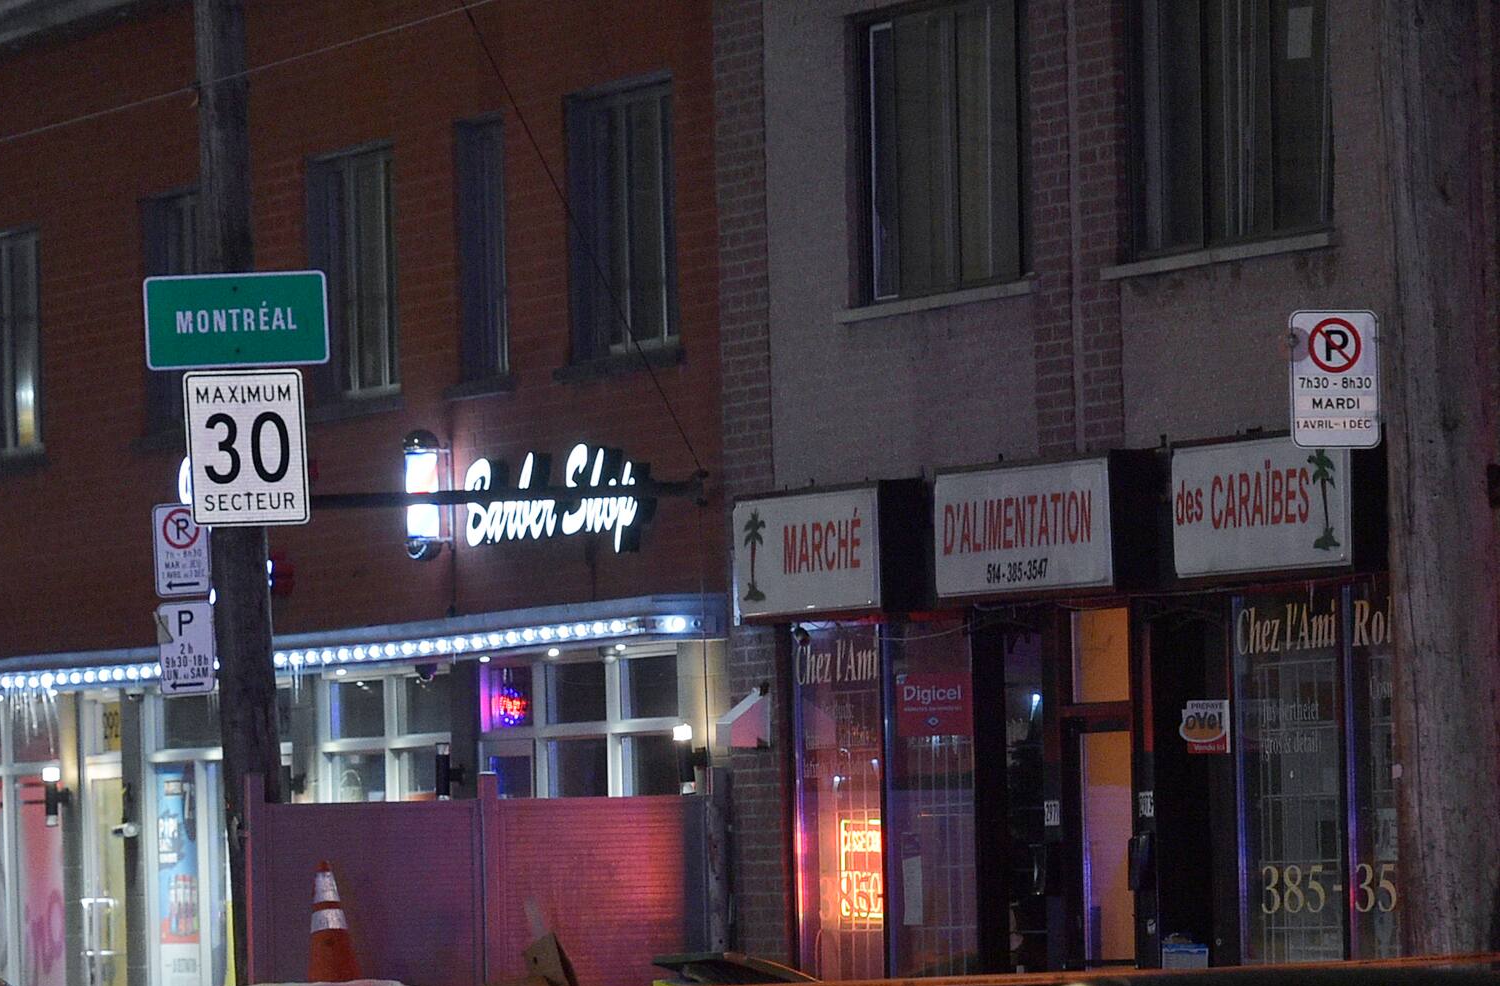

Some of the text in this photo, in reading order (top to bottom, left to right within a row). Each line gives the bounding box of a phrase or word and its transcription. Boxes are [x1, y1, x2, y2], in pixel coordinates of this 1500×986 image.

[176, 300, 298, 334] MONTRÉAL
[195, 383, 292, 405] MAXIMUM
[1299, 377, 1329, 389] 7h30
[1341, 377, 1372, 389] 8h30
[1312, 397, 1360, 409] MARDI
[203, 411, 290, 485] 30
[203, 491, 296, 512] SECTEUR
[465, 443, 638, 553] Barber Shop
[1175, 458, 1310, 529] des CARAÏBES
[783, 506, 862, 575] MARCHÉ
[943, 490, 1092, 556] D'ALIMENTATION
[178, 610, 194, 637] P
[1237, 607, 1281, 656] Chez
[1285, 599, 1337, 650] l'Ami
[795, 644, 832, 686] Chez
[903, 685, 962, 705] Digicel
